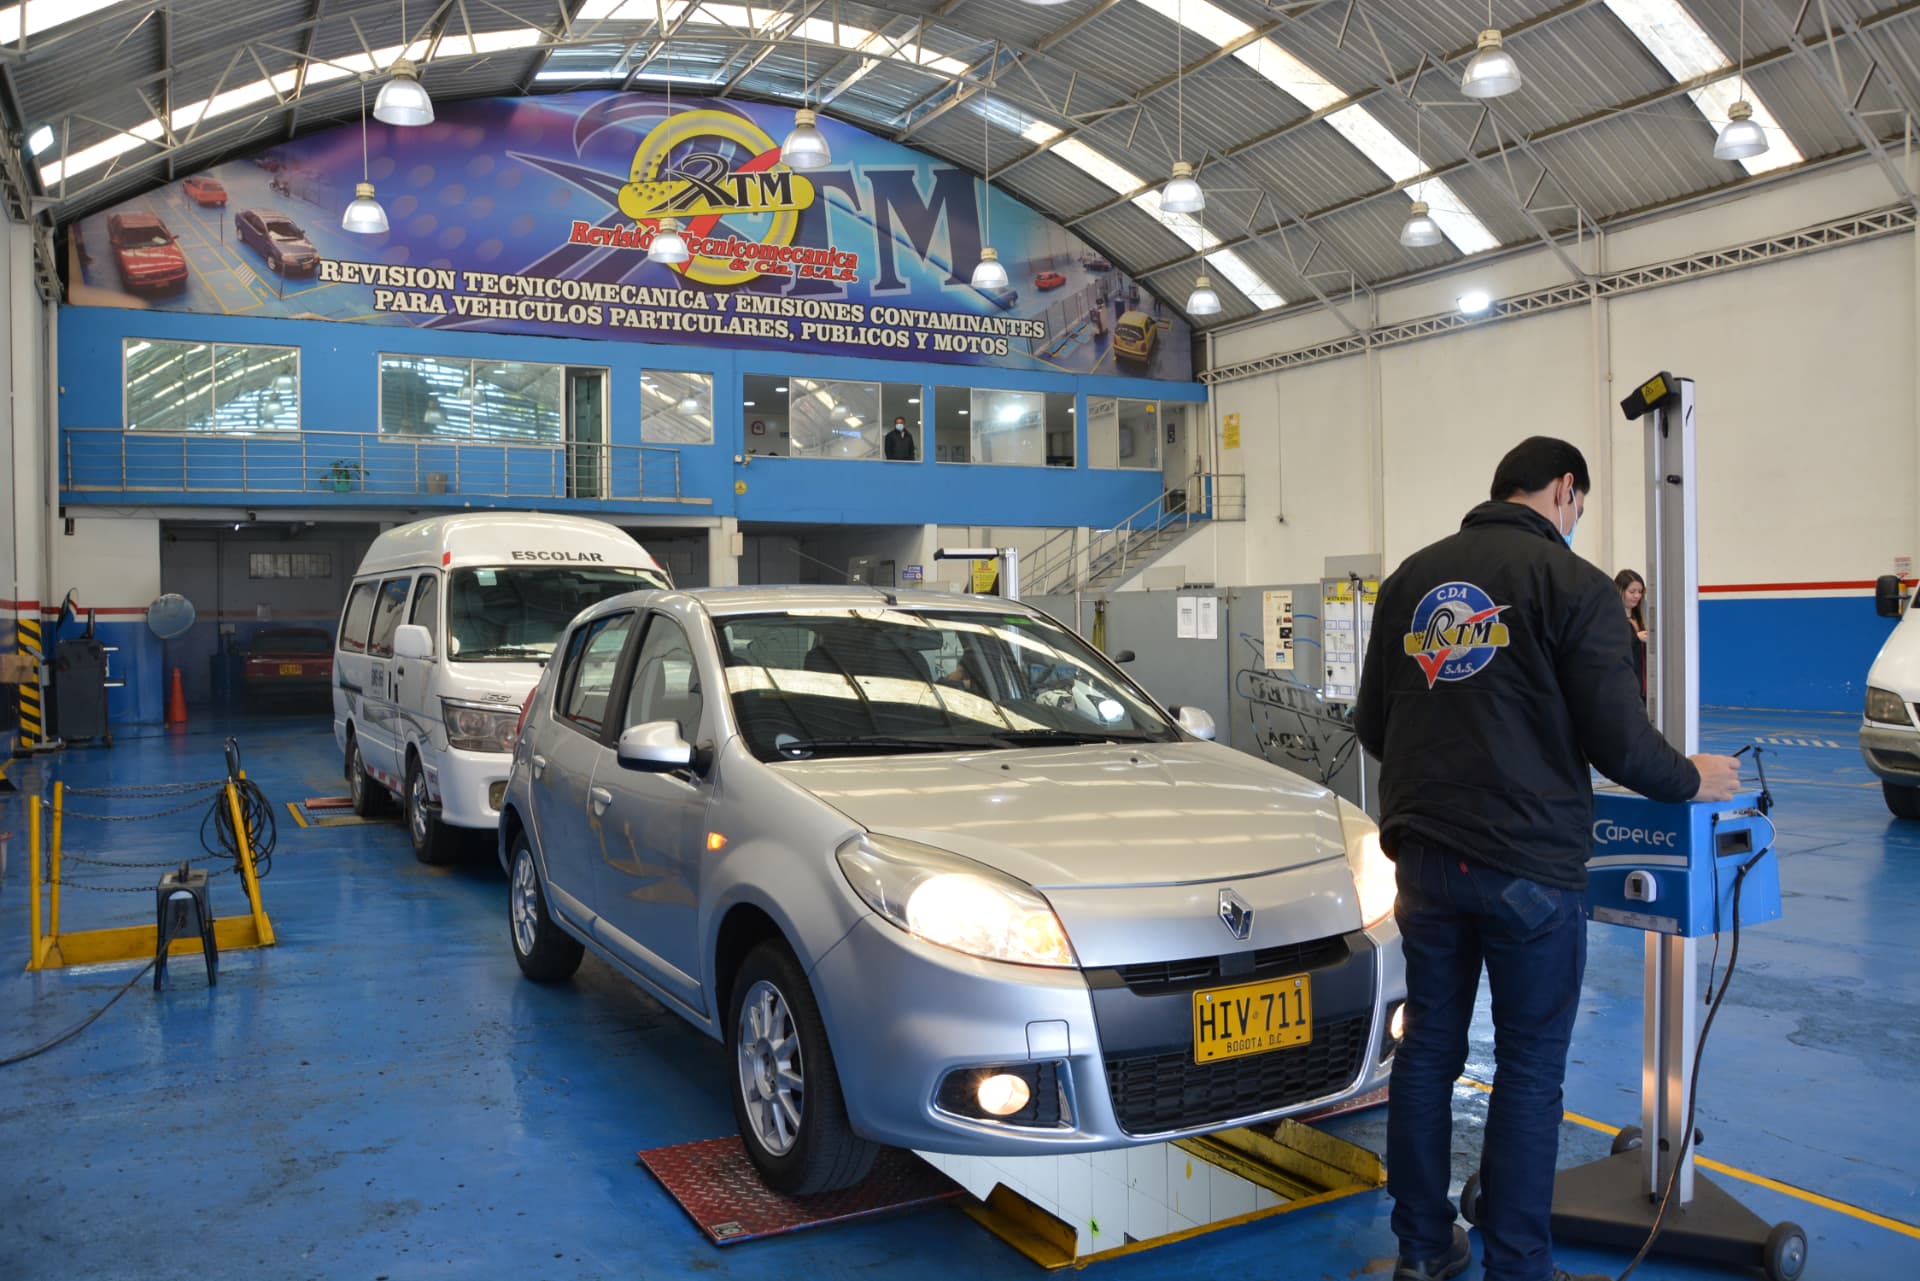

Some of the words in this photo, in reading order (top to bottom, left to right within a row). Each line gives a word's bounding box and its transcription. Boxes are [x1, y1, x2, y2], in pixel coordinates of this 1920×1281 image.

[569, 221, 655, 250] Revisió
[680, 231, 858, 270] Tecnicomecanica
[753, 260, 794, 276] Cia.
[799, 264, 858, 282] S.A.S.
[318, 259, 456, 291] REVISION
[462, 272, 709, 309] TECNICOMECANICA
[714, 291, 729, 312] Y
[735, 293, 865, 323] EMISIONES
[869, 306, 1046, 339] CONTAMINANTES
[374, 290, 448, 315] PARA
[452, 296, 602, 326] VEHICULOS
[609, 308, 795, 342] PARTICULARES,
[800, 320, 910, 348] PUBLICOS
[914, 331, 930, 351] Y
[933, 333, 1009, 356] MOTOS
[511, 550, 605, 563] ESCOLAR
[1436, 587, 1468, 601] CDA
[1421, 607, 1493, 651] RTM
[1591, 819, 1677, 847] Capelec
[1199, 997, 1251, 1043] HIV
[1259, 988, 1306, 1031] 711
[1227, 1037, 1263, 1053] BOGOTA
